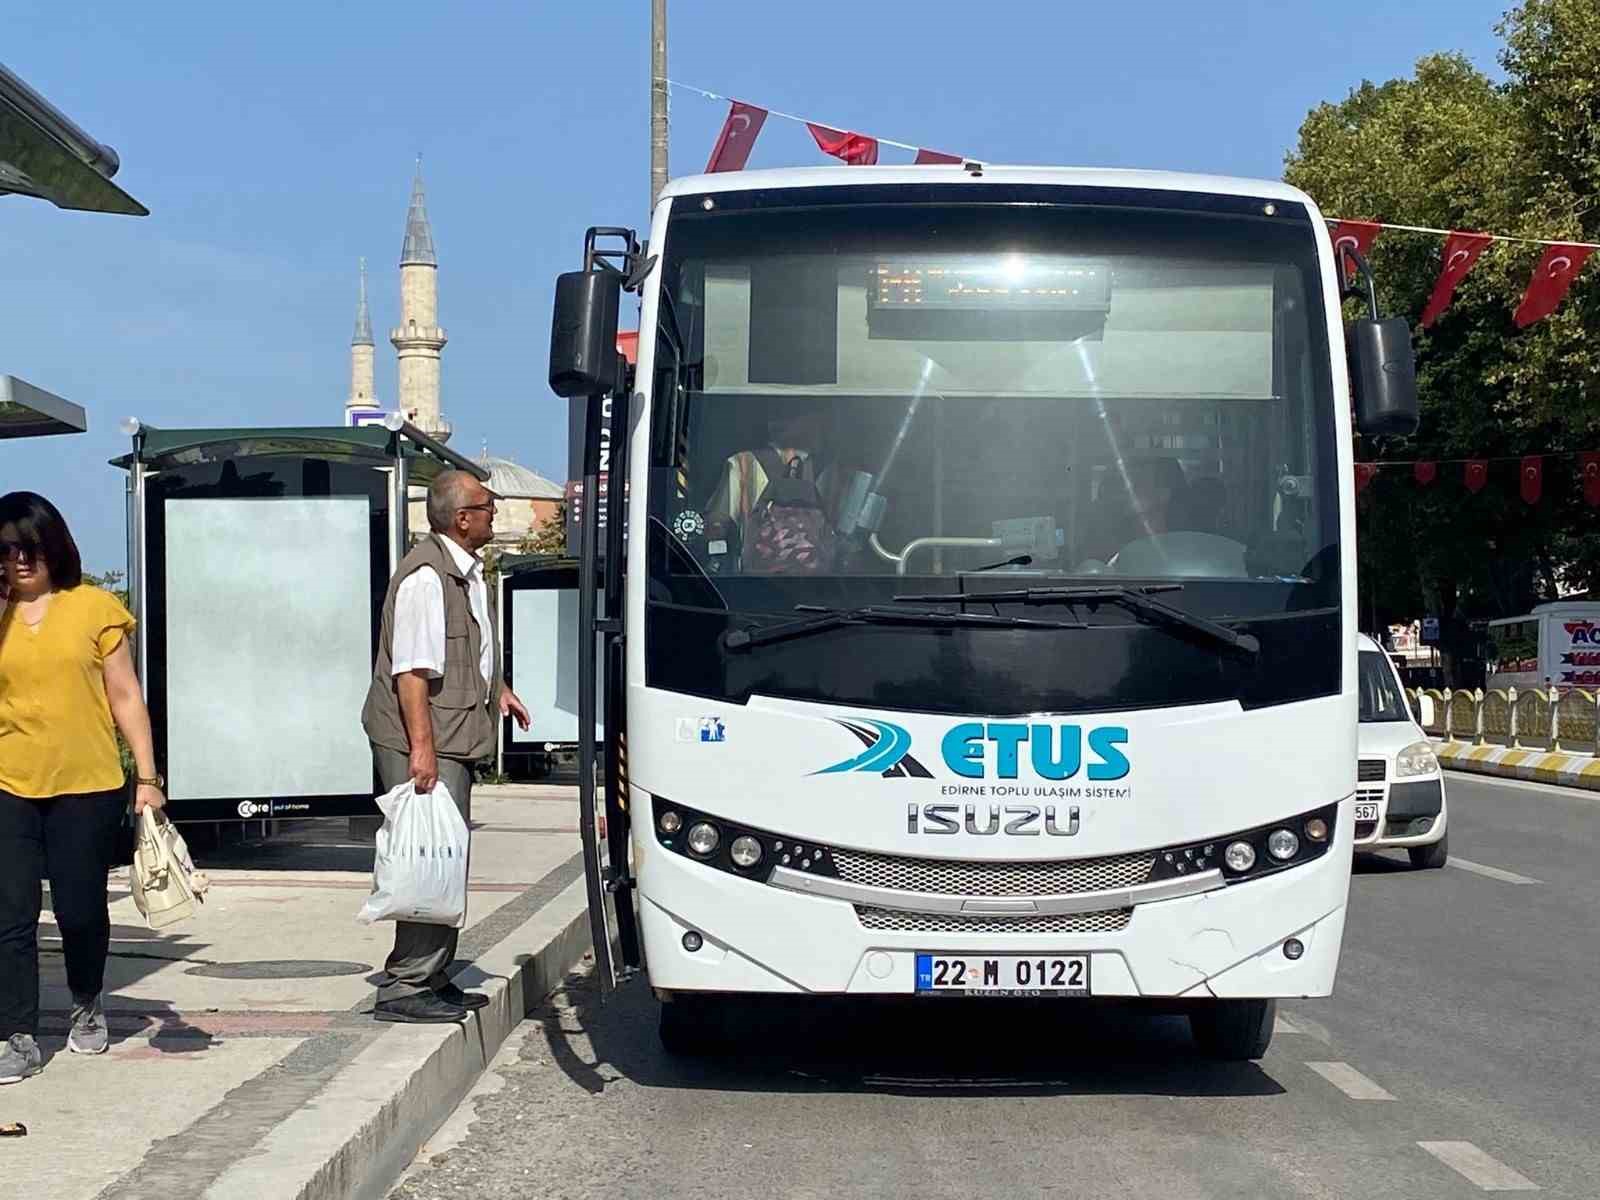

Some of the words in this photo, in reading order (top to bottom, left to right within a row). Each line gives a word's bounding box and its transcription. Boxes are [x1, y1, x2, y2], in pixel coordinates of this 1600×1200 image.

[941, 723, 1130, 781] ETUS
[941, 784, 986, 796] EDİRNE
[991, 786, 1029, 797] TOPLU
[1034, 786, 1081, 799] ULAŞIM
[907, 803, 1080, 836] ISUZU
[934, 960, 967, 986] 22
[984, 960, 998, 986] M
[1016, 960, 1083, 986] 0122
